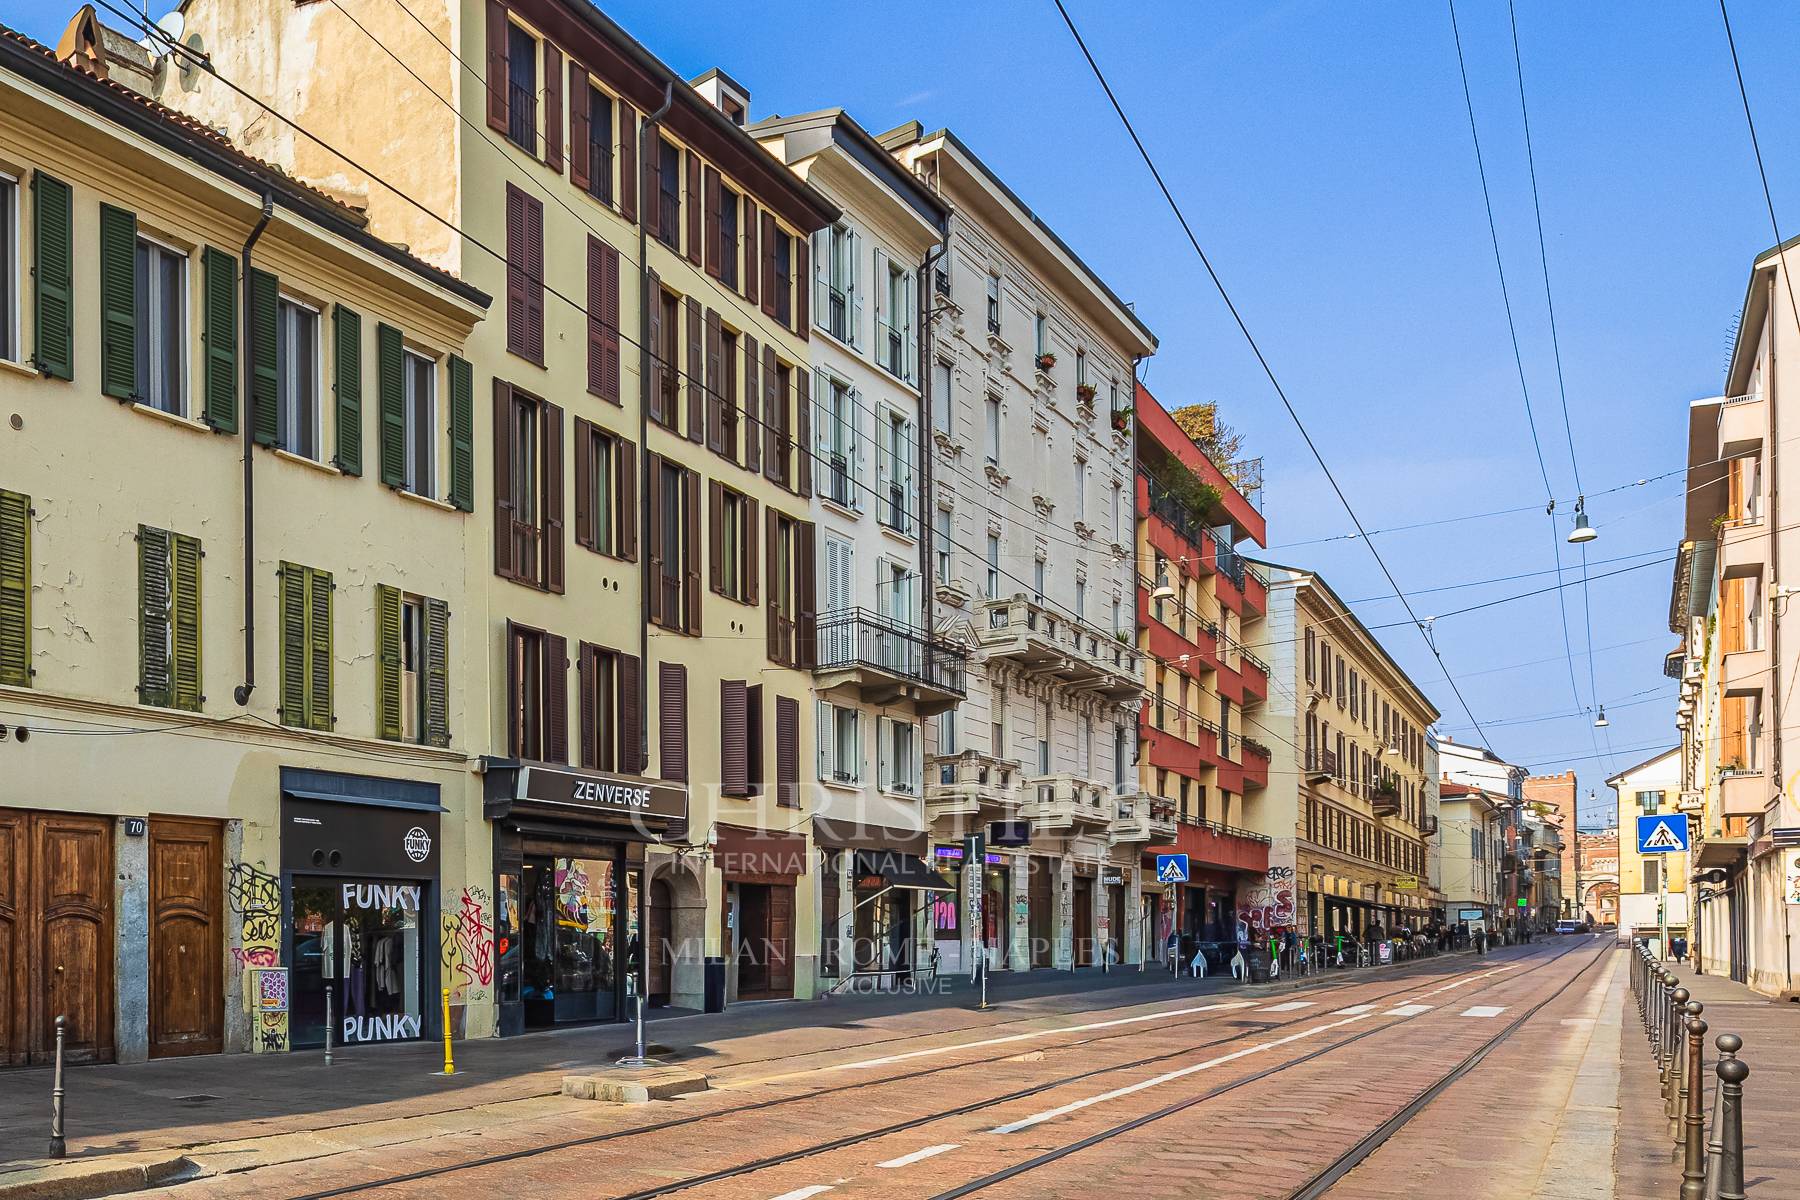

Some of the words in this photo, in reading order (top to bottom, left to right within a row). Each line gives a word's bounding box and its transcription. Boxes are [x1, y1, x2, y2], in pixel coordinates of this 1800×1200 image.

[573, 780, 651, 808] ZENVERSE
[130, 821, 143, 833] 70
[405, 838, 431, 851] FUNKY
[342, 883, 421, 911] FUNKY
[343, 1014, 422, 1043] PUNKY
